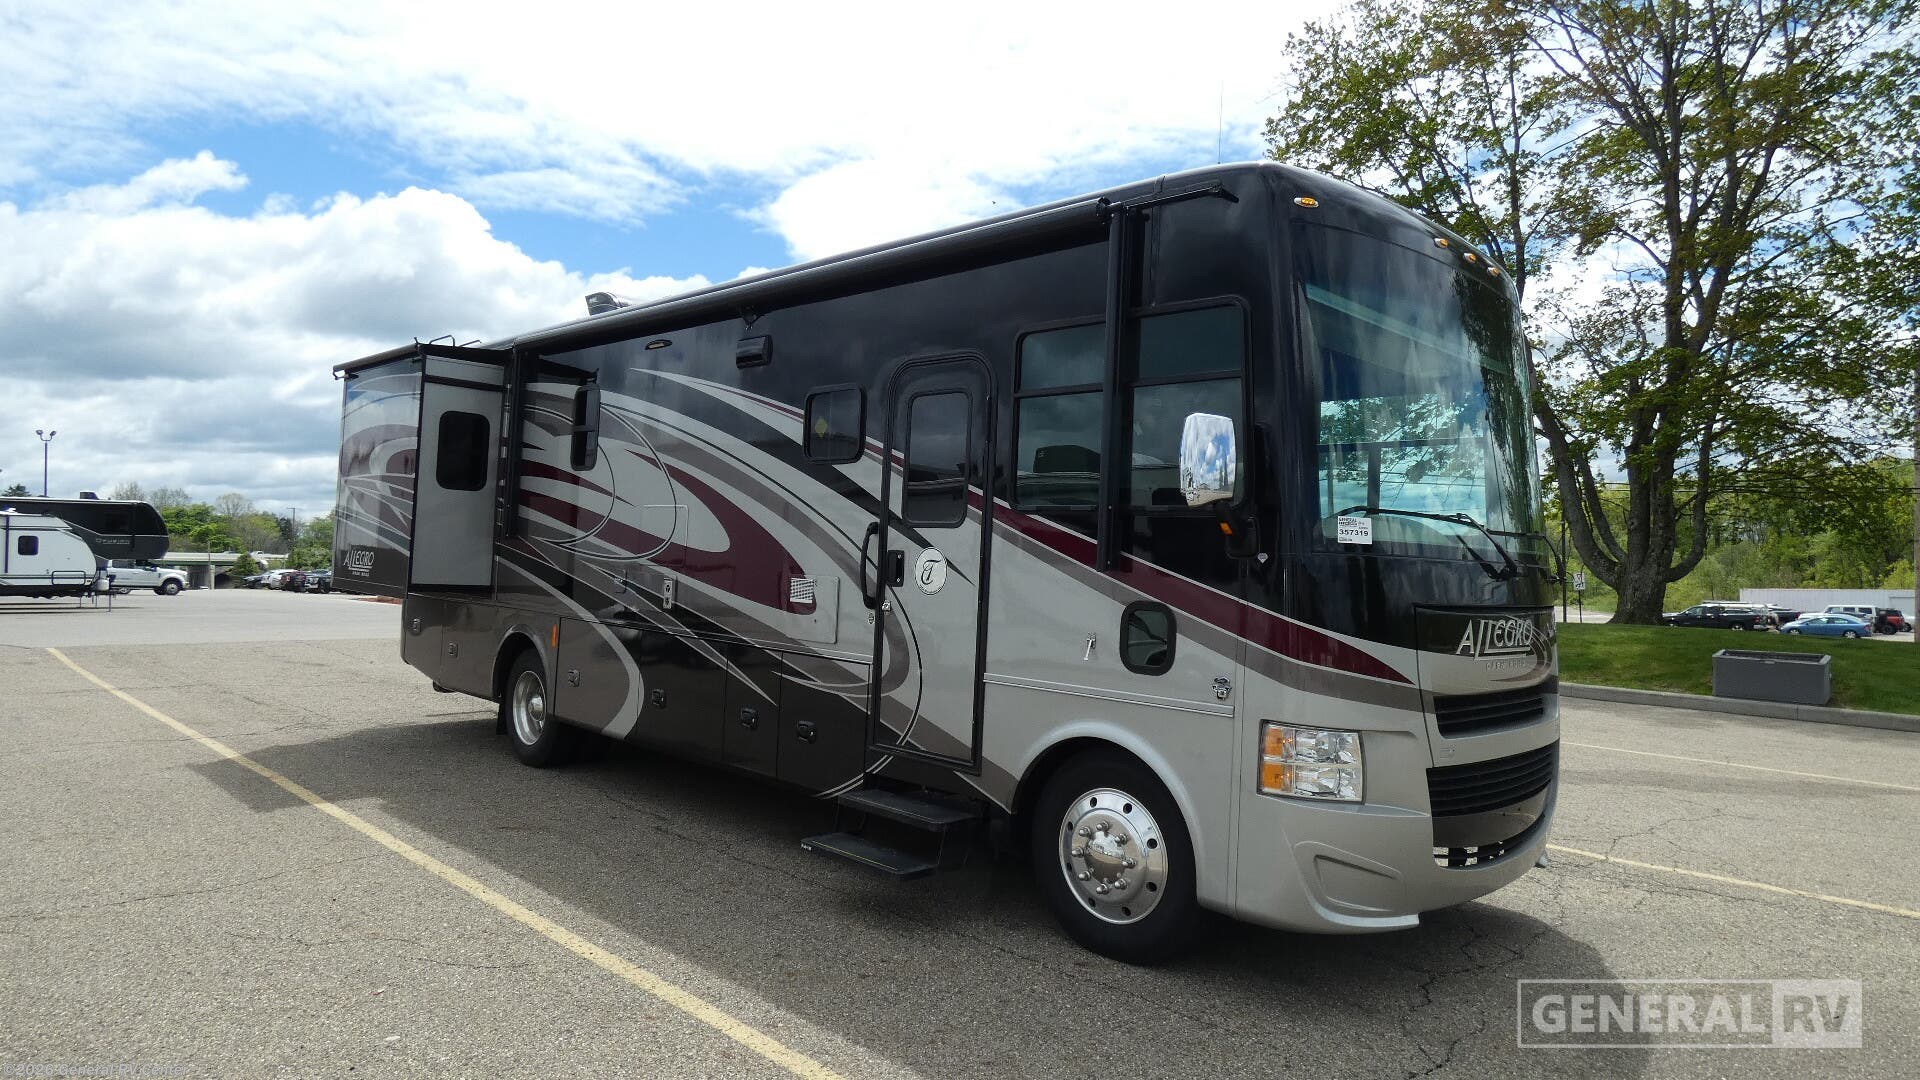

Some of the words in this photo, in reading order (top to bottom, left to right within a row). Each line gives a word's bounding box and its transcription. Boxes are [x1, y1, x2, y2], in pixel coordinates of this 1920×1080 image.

[1339, 528, 1369, 537] 357319
[343, 549, 375, 571] ALLEGRO
[1456, 619, 1533, 661] ALLEGRO
